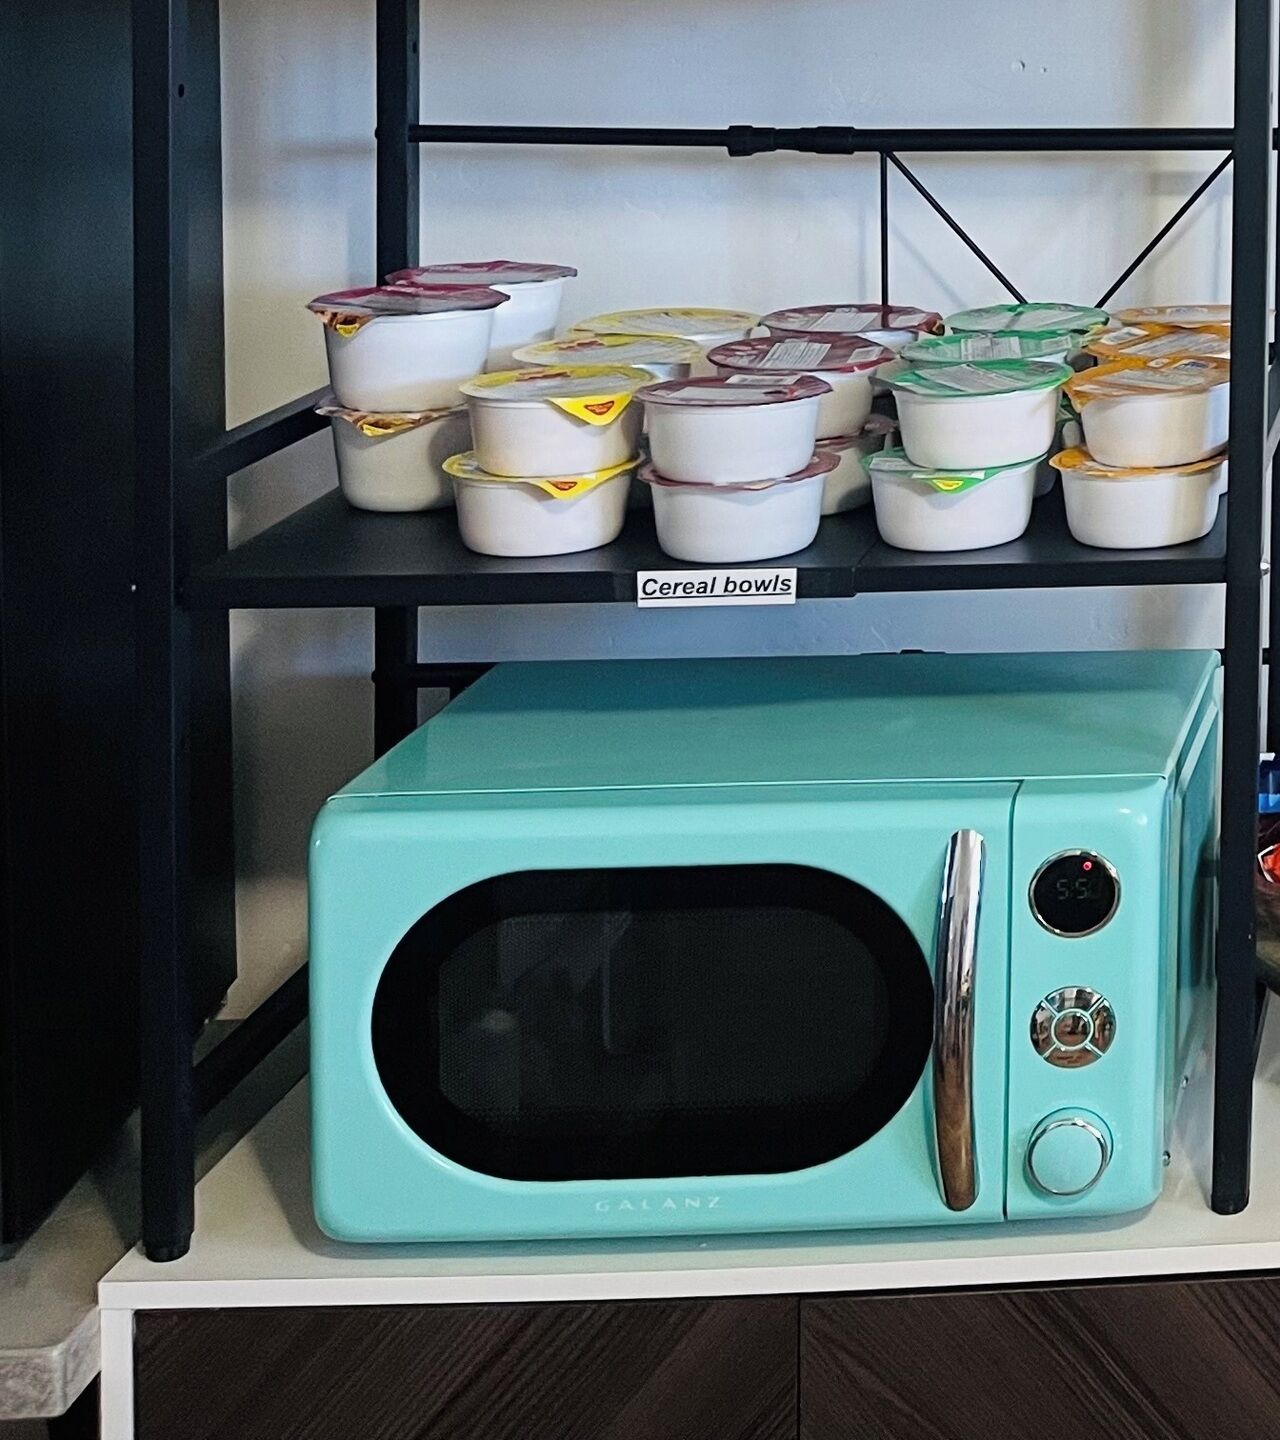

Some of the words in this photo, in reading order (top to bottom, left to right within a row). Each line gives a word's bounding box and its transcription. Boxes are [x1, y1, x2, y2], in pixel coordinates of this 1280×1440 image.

[641, 577, 716, 597] Cereal
[723, 574, 792, 594] bowls
[595, 1196, 721, 1211] GALANZ
